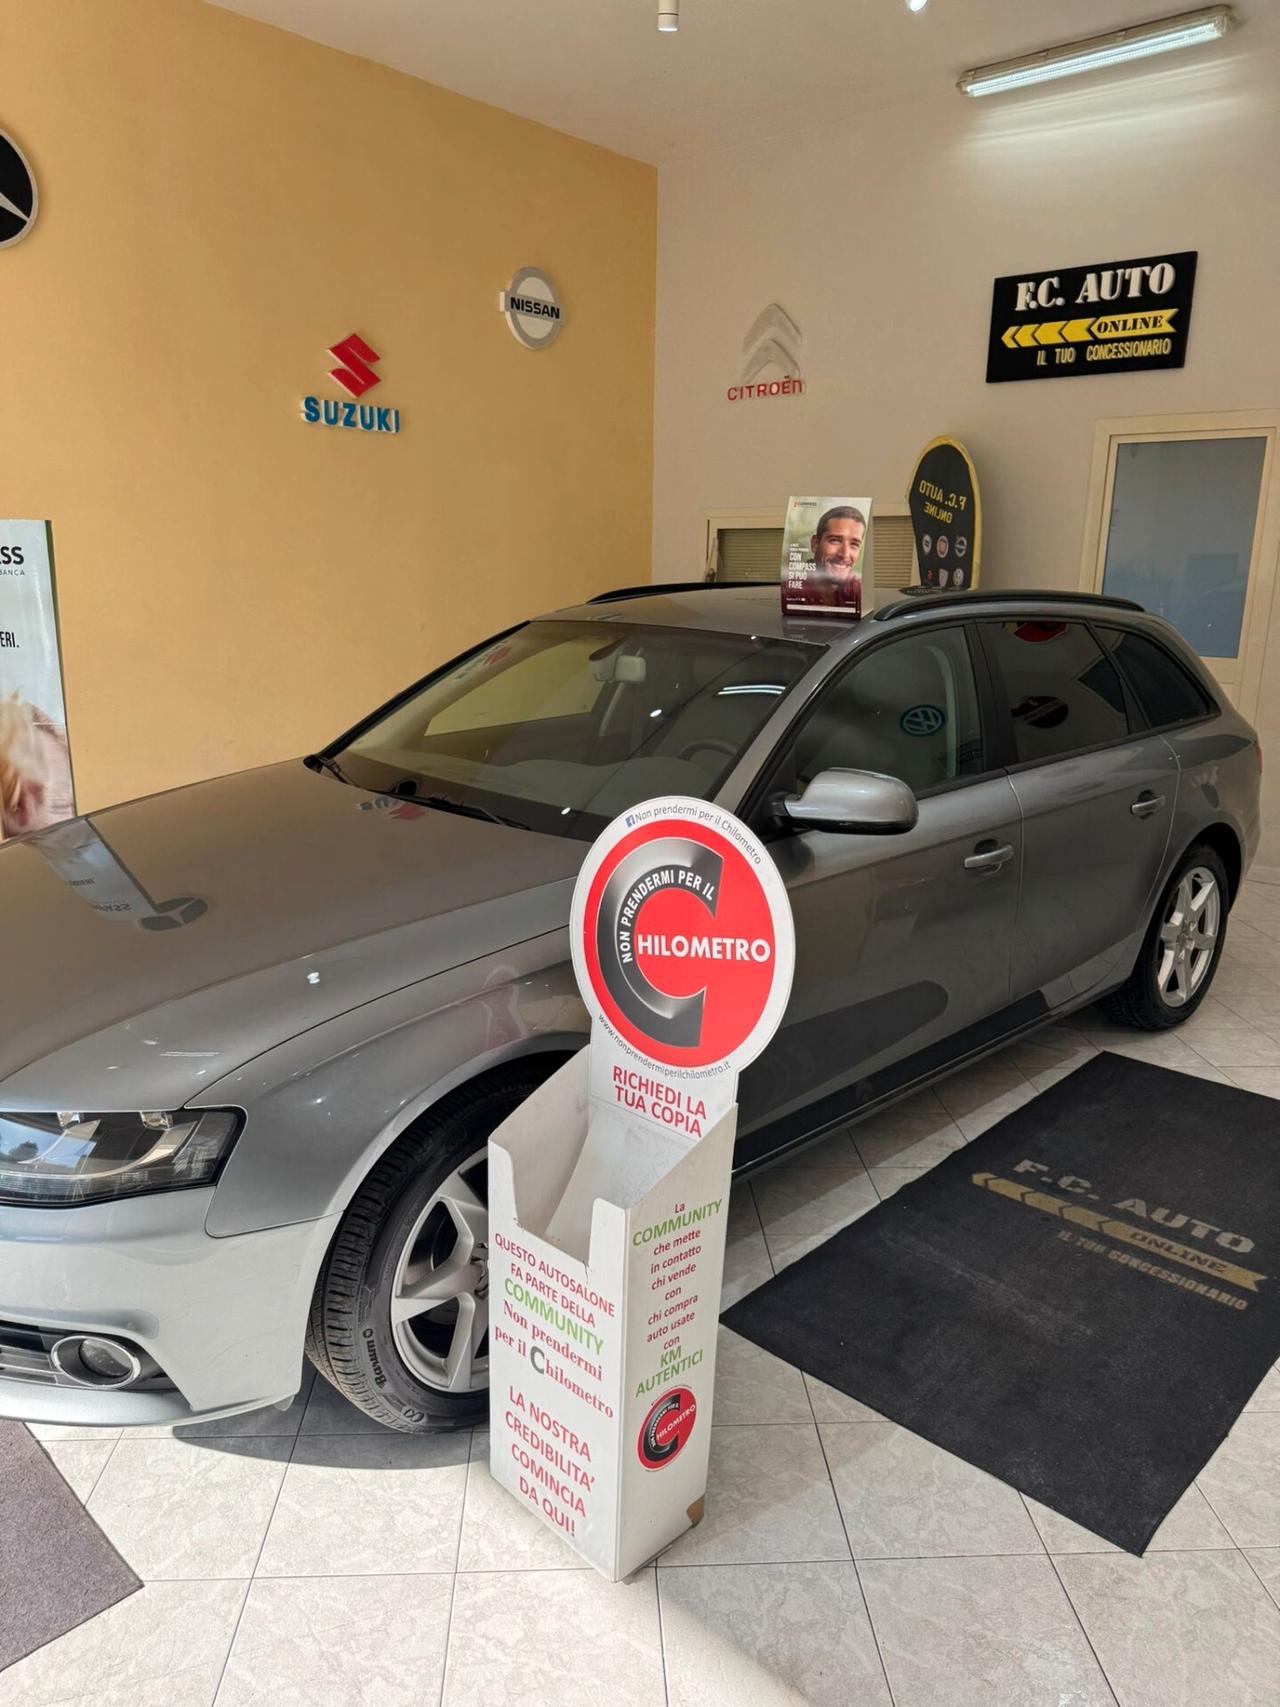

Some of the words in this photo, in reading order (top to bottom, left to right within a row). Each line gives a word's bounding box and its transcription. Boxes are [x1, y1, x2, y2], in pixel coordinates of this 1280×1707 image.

[1015, 277, 1065, 311] F.C.
[1075, 263, 1176, 304] AUTO
[510, 296, 560, 319] NISSAN
[1097, 315, 1164, 334] ONLINE
[1036, 350, 1048, 366] IL
[1055, 347, 1076, 364] TUO
[1086, 338, 1172, 361] CONCESSIONARIO
[302, 396, 400, 432] SUZUKI
[0, 546, 24, 565] SS
[788, 562, 816, 572] COMPASS
[789, 552, 802, 561] CON
[788, 580, 803, 589] FARE
[635, 810, 652, 823] Non
[654, 804, 698, 816] prendermi
[700, 810, 714, 822] per
[714, 815, 721, 826] il
[721, 820, 761, 865] Chilometro
[621, 869, 675, 927] PRENDERMI
[678, 870, 702, 891] PER
[702, 882, 716, 901] IL
[620, 931, 633, 964] NON
[599, 1014, 731, 1079] www.nonprendermiperilchilometro.it
[613, 1065, 681, 1108] RICHIEDI
[687, 1096, 707, 1120] LA
[615, 1085, 647, 1113] TUA
[651, 1102, 701, 1138] COPIA
[632, 1198, 722, 1246] COMMUNITY
[675, 1203, 685, 1213] La
[1112, 1198, 1255, 1253] AUTO
[650, 1263, 660, 1274] in
[662, 1246, 701, 1269] contatto
[653, 1242, 671, 1255] che
[673, 1230, 701, 1248] mette
[1130, 1231, 1228, 1274] ONLINE
[495, 1233, 536, 1267] QUESTO
[538, 1260, 615, 1318] AUTOSALONE
[651, 1275, 666, 1290] chi
[668, 1263, 696, 1282] vende
[1074, 1236, 1107, 1255] TUO
[1108, 1249, 1249, 1311] CONCESSIONARIO
[511, 1263, 523, 1280] FA
[525, 1272, 558, 1303] PARTE
[561, 1295, 595, 1328] DELLA
[648, 1310, 662, 1325] chi
[664, 1295, 698, 1317] compra
[665, 1287, 682, 1300] con
[505, 1278, 604, 1356] COMMUNITY
[647, 1326, 669, 1343] auto
[671, 1312, 695, 1330] usate
[504, 1299, 528, 1329] Non
[532, 1324, 602, 1381] prendermi
[661, 1345, 682, 1368] KM
[664, 1336, 680, 1350] con
[495, 1326, 515, 1347] per
[518, 1338, 526, 1357] il
[530, 1346, 613, 1418] Chilometro
[636, 1349, 703, 1398] AUTENTICI
[510, 1385, 525, 1412] LA
[530, 1402, 591, 1462] NOSTRA
[512, 1443, 586, 1518] COMINCIA
[520, 1476, 539, 1506] DA
[542, 1498, 575, 1537] QUI!
